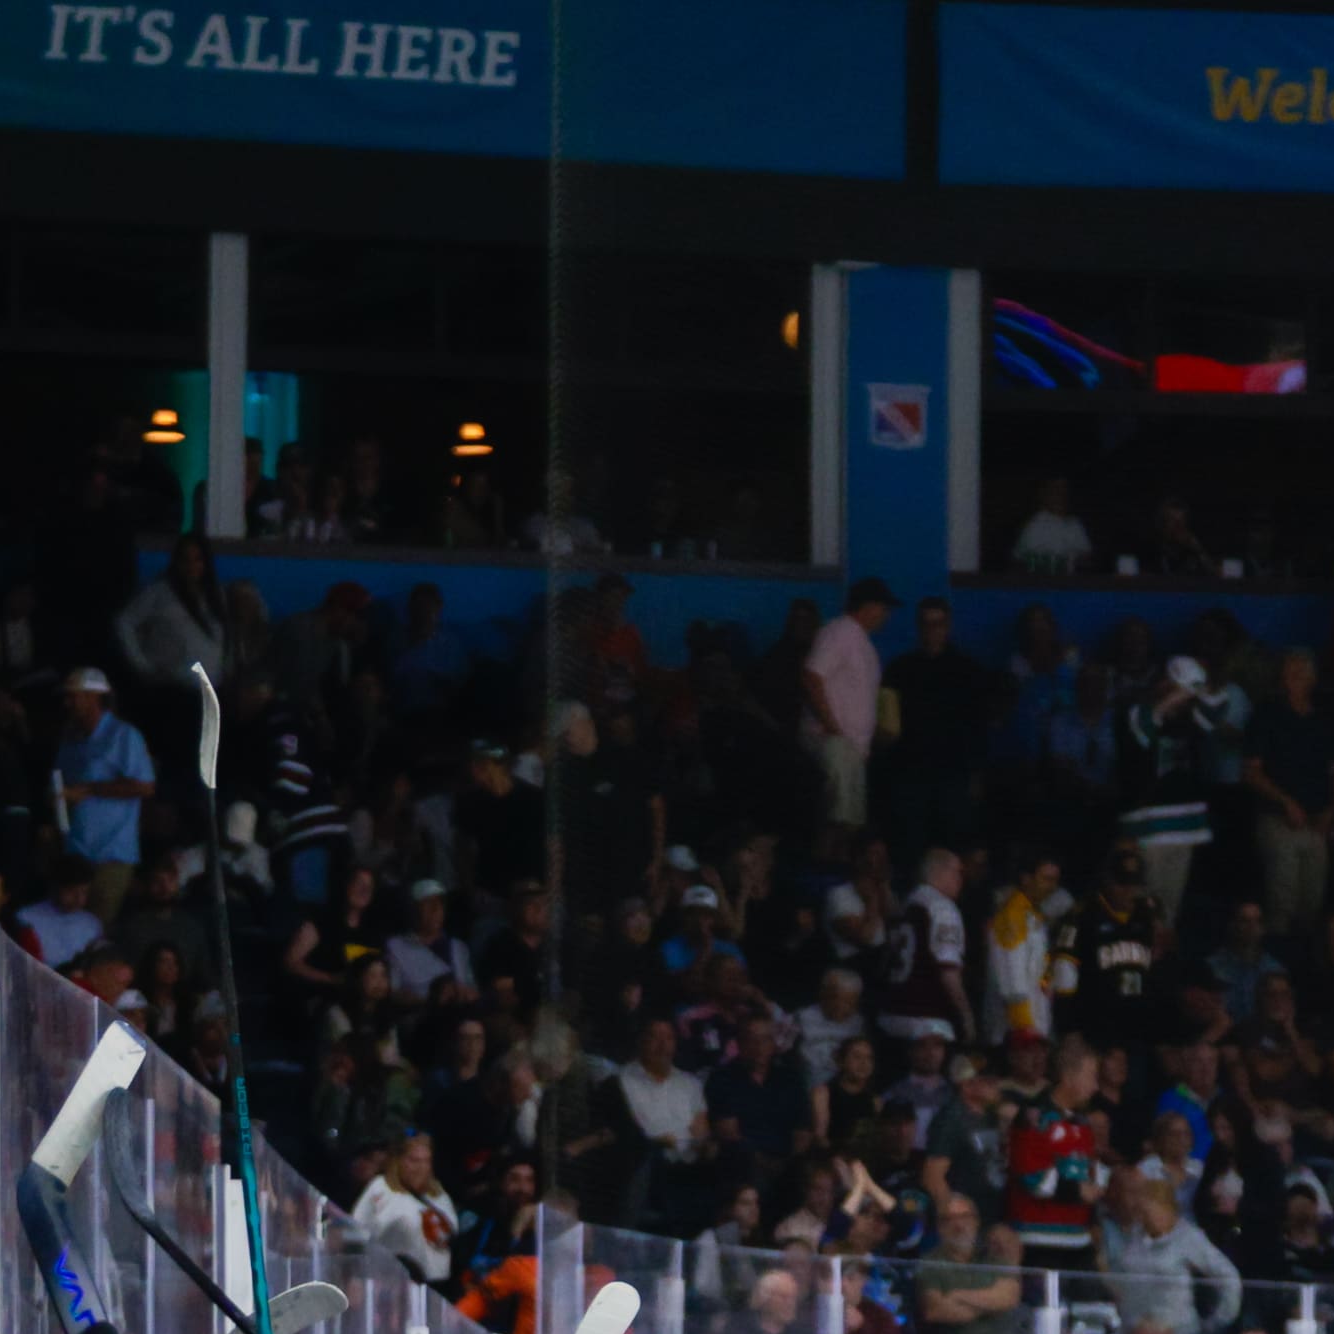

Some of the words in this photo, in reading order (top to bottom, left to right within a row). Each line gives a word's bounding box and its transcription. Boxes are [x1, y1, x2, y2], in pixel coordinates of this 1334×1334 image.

[45, 4, 175, 66] IT'S
[186, 15, 320, 76] ALL
[335, 21, 520, 88] HERE
